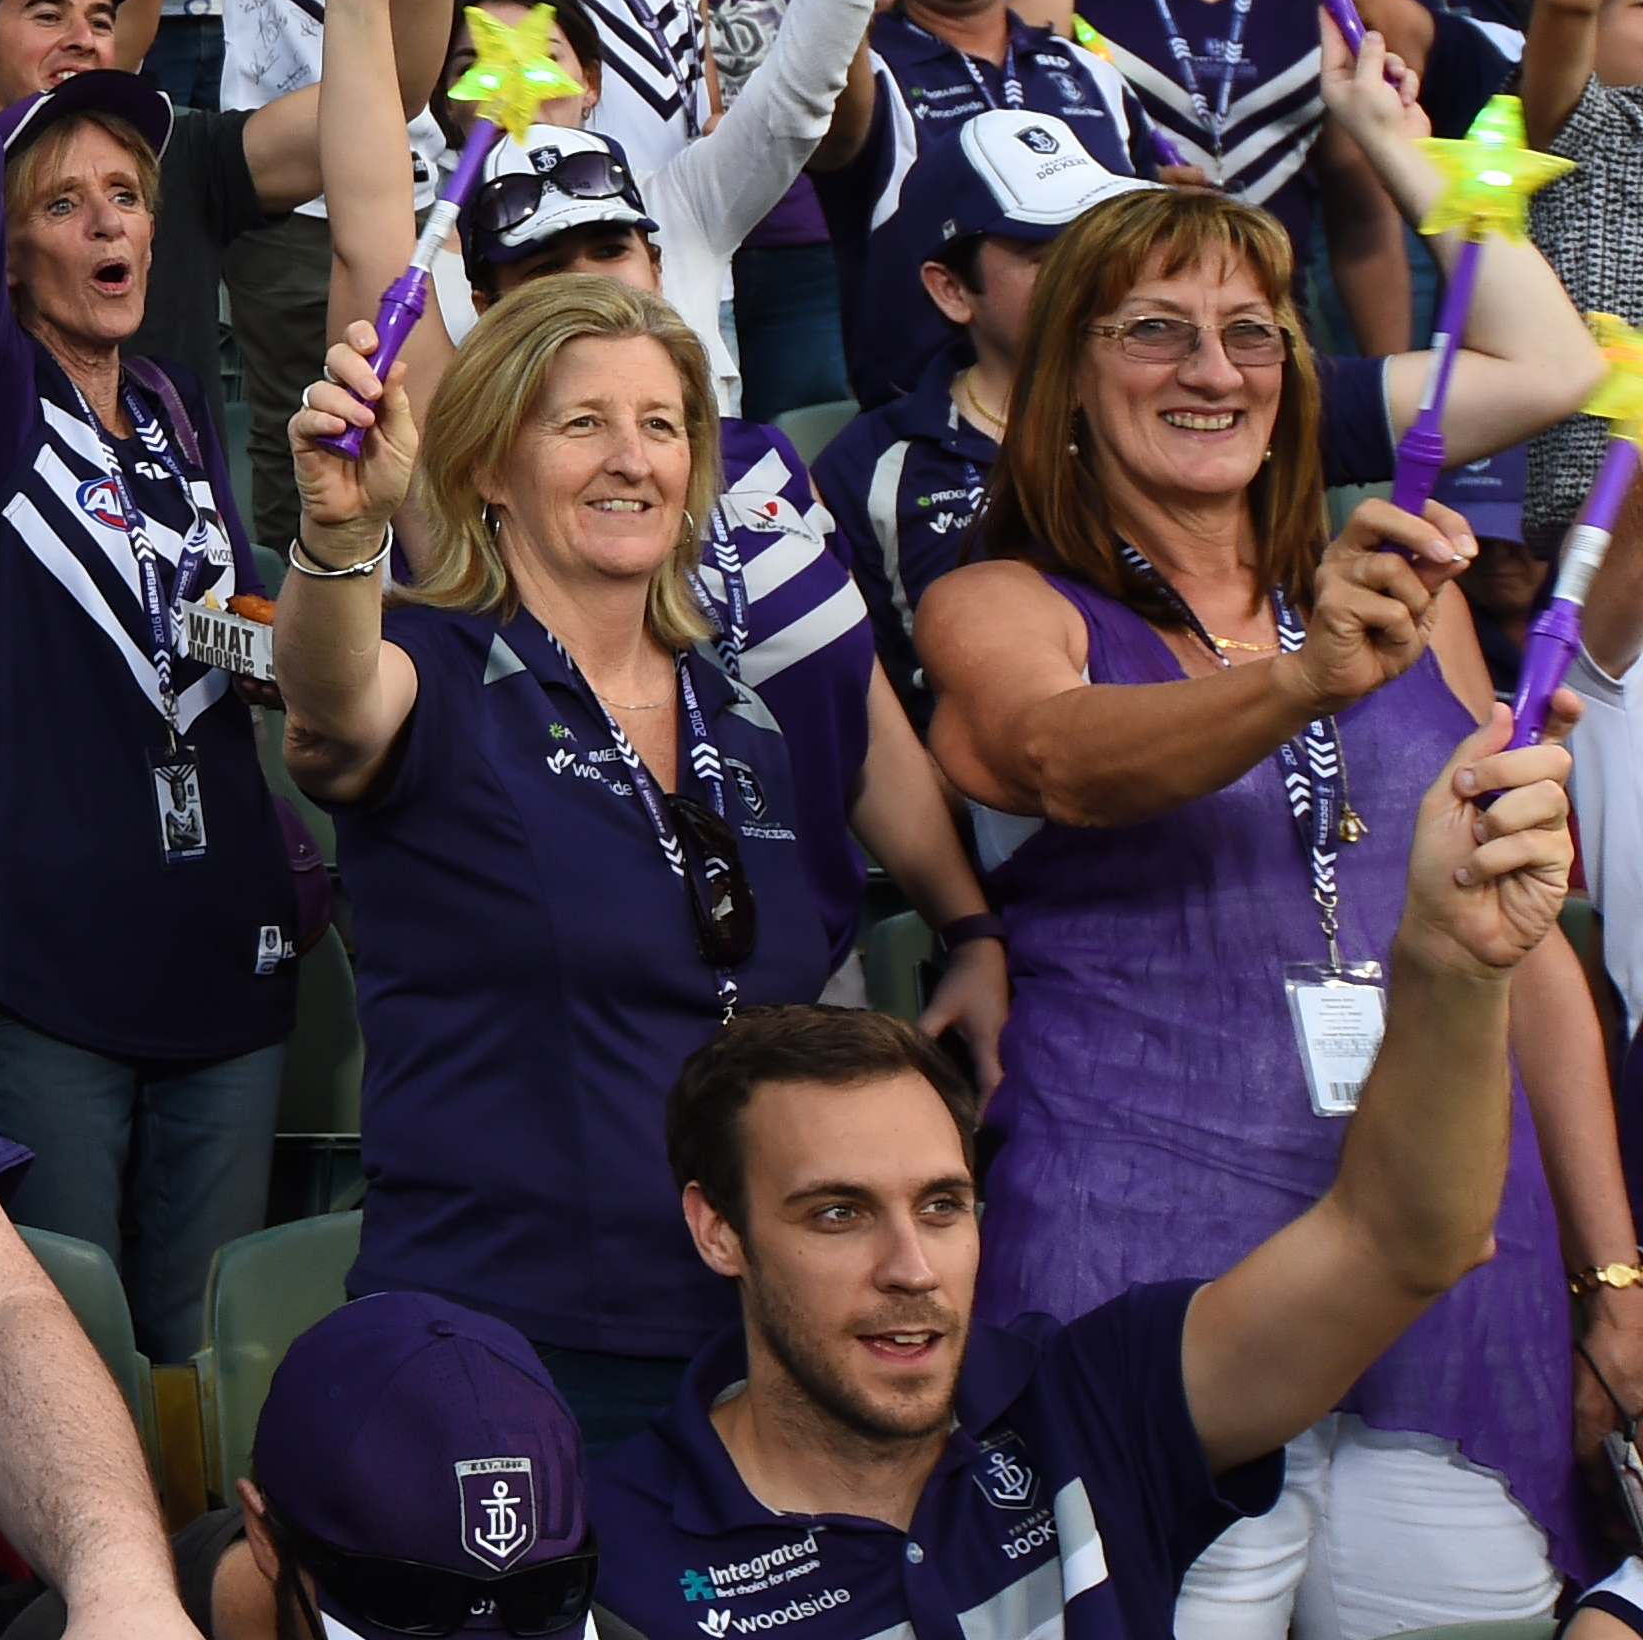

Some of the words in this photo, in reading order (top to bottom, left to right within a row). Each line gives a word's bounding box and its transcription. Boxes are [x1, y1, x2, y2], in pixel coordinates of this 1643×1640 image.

[1035, 156, 1089, 181] DOCKERS
[144, 562, 160, 618] MEMBER
[731, 587, 744, 624] DOCKERS
[151, 616, 166, 644] 2016
[188, 613, 255, 658] WHAT
[680, 665, 699, 710] MEMBER
[689, 709, 707, 738] 2016
[642, 789, 666, 834] DOCKERS
[1317, 798, 1330, 846] DOCKERS
[1008, 1508, 1051, 1537] FREMAN
[708, 1533, 819, 1586] Integrated
[736, 1581, 769, 1596] choice
[768, 1571, 785, 1587] for
[785, 1559, 821, 1582] people
[731, 1588, 851, 1635] woodside
